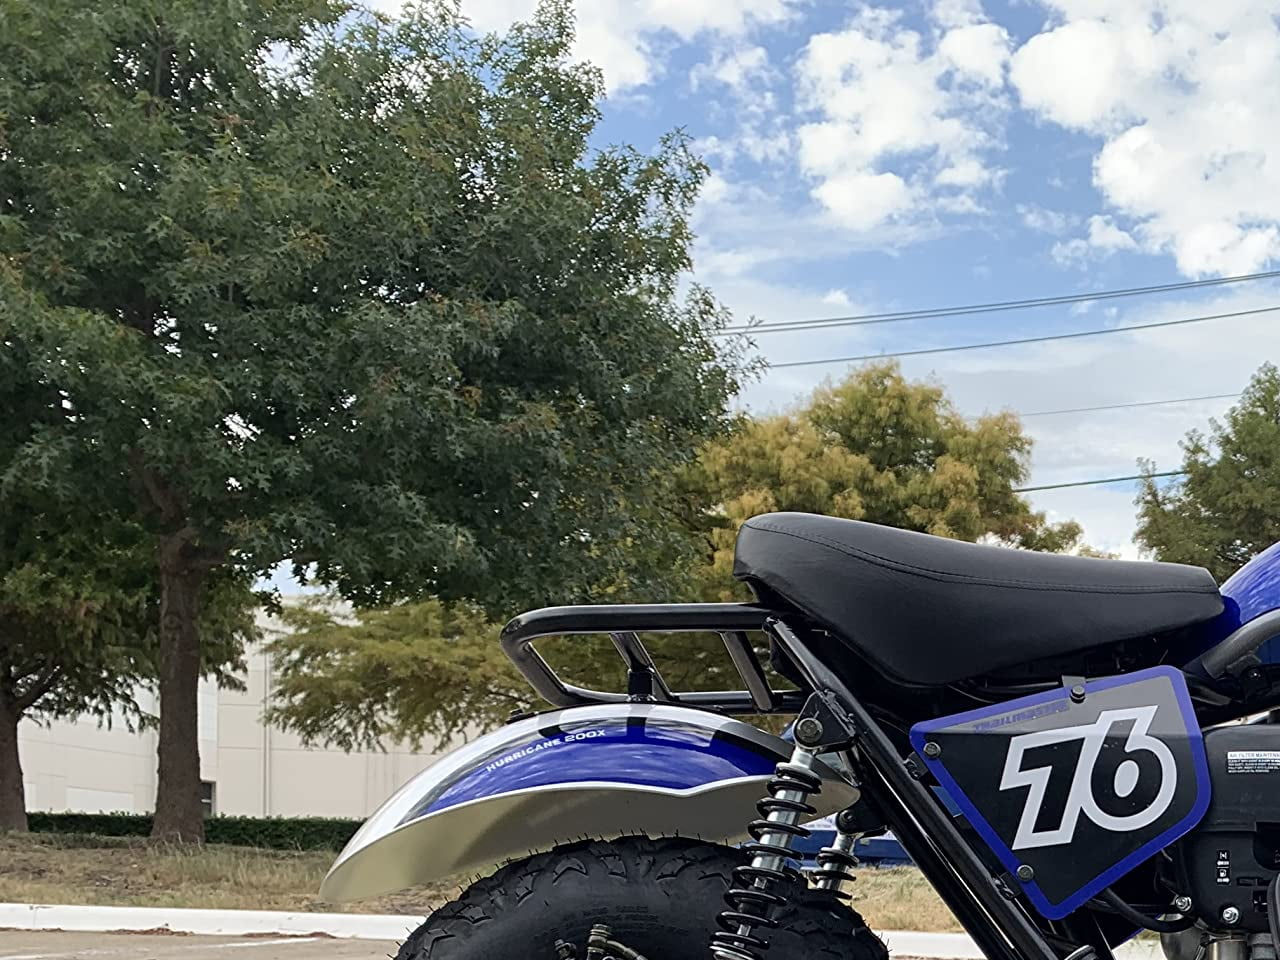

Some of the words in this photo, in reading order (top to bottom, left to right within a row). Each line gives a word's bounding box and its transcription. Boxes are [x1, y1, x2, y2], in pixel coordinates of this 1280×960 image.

[486, 738, 561, 772] HURRICANE
[564, 729, 606, 742] 200X
[999, 705, 1178, 850] 76
